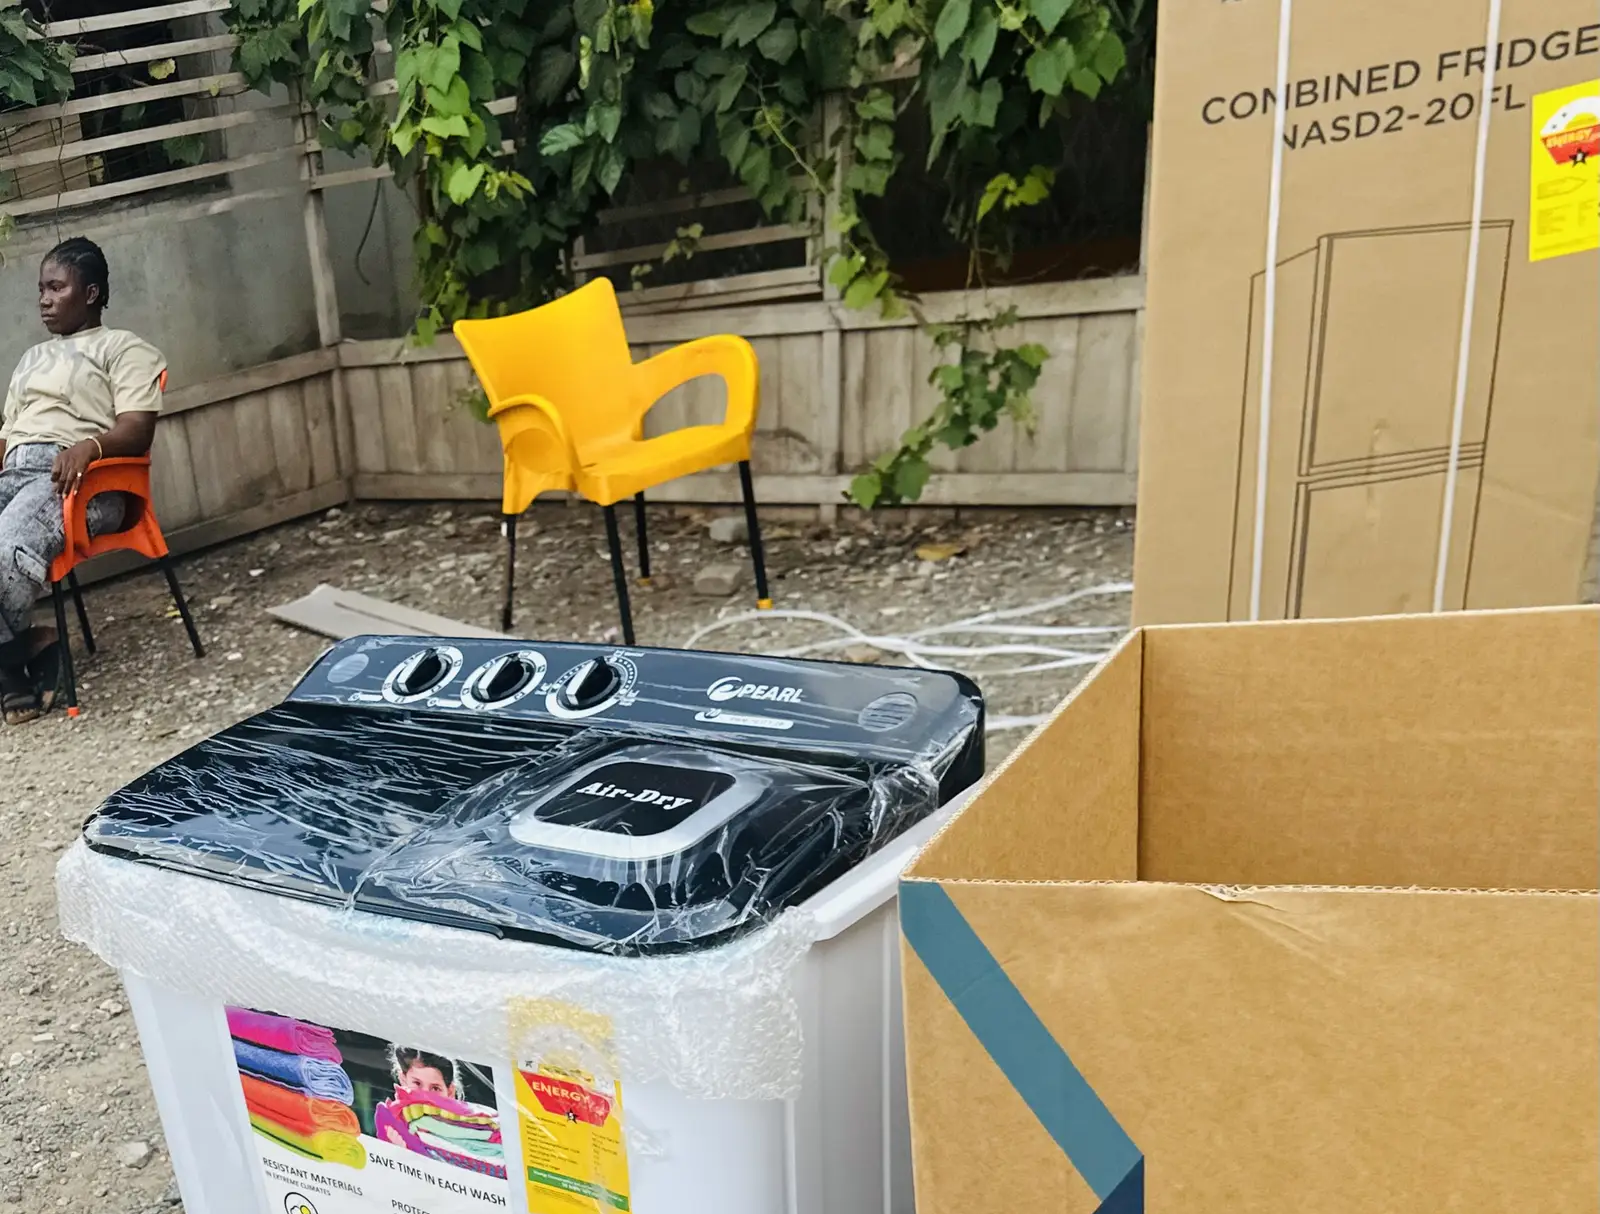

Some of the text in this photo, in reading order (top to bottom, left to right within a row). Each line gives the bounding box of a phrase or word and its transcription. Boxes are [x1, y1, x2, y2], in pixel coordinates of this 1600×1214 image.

[1202, 28, 1600, 125] COMBINED FRIDGE
[738, 684, 803, 702] PEARL
[576, 782, 692, 810] Air-Dry
[532, 1081, 590, 1103] ENERGY
[263, 1157, 363, 1196] RESISTANT MATERIALS
[273, 1173, 299, 1187] EXTREME
[300, 1182, 331, 1196] CLIMATES
[369, 1152, 506, 1206] SAVE TIME IN EACH WASH
